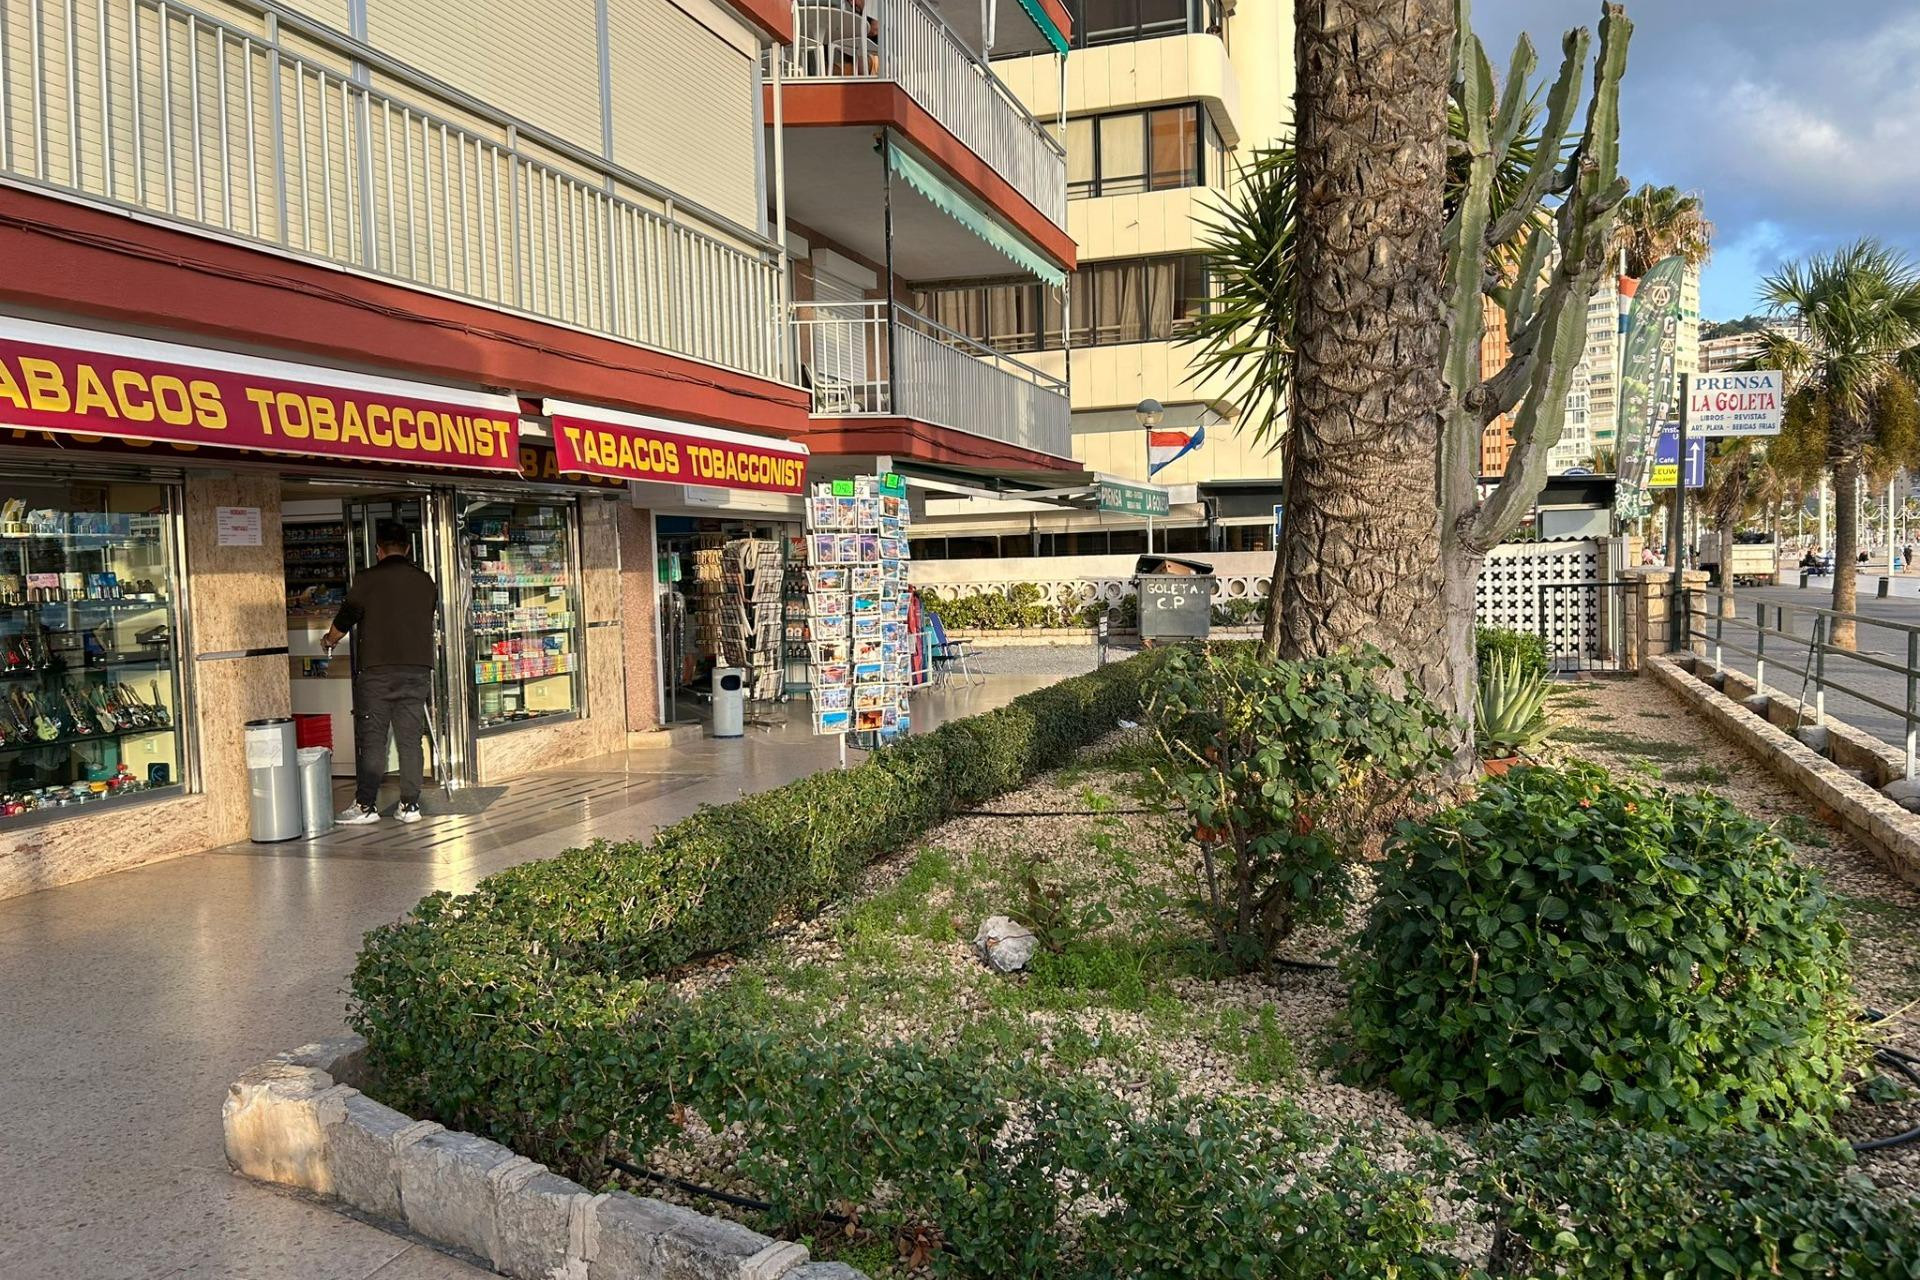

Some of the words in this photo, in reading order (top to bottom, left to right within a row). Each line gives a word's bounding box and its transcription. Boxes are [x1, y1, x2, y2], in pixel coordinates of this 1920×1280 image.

[1695, 376, 1773, 390] PRENSA
[1691, 395, 1711, 412] LA
[1715, 391, 1776, 411] GOLETA
[245, 387, 510, 458] TOBACCONIST
[1700, 414, 1724, 422] LIBROS
[1734, 412, 1767, 421] REVISTAS
[1732, 423, 1757, 431] BEBIDAS
[563, 426, 680, 474] TABACOS
[687, 445, 804, 487] TOBACCONIST
